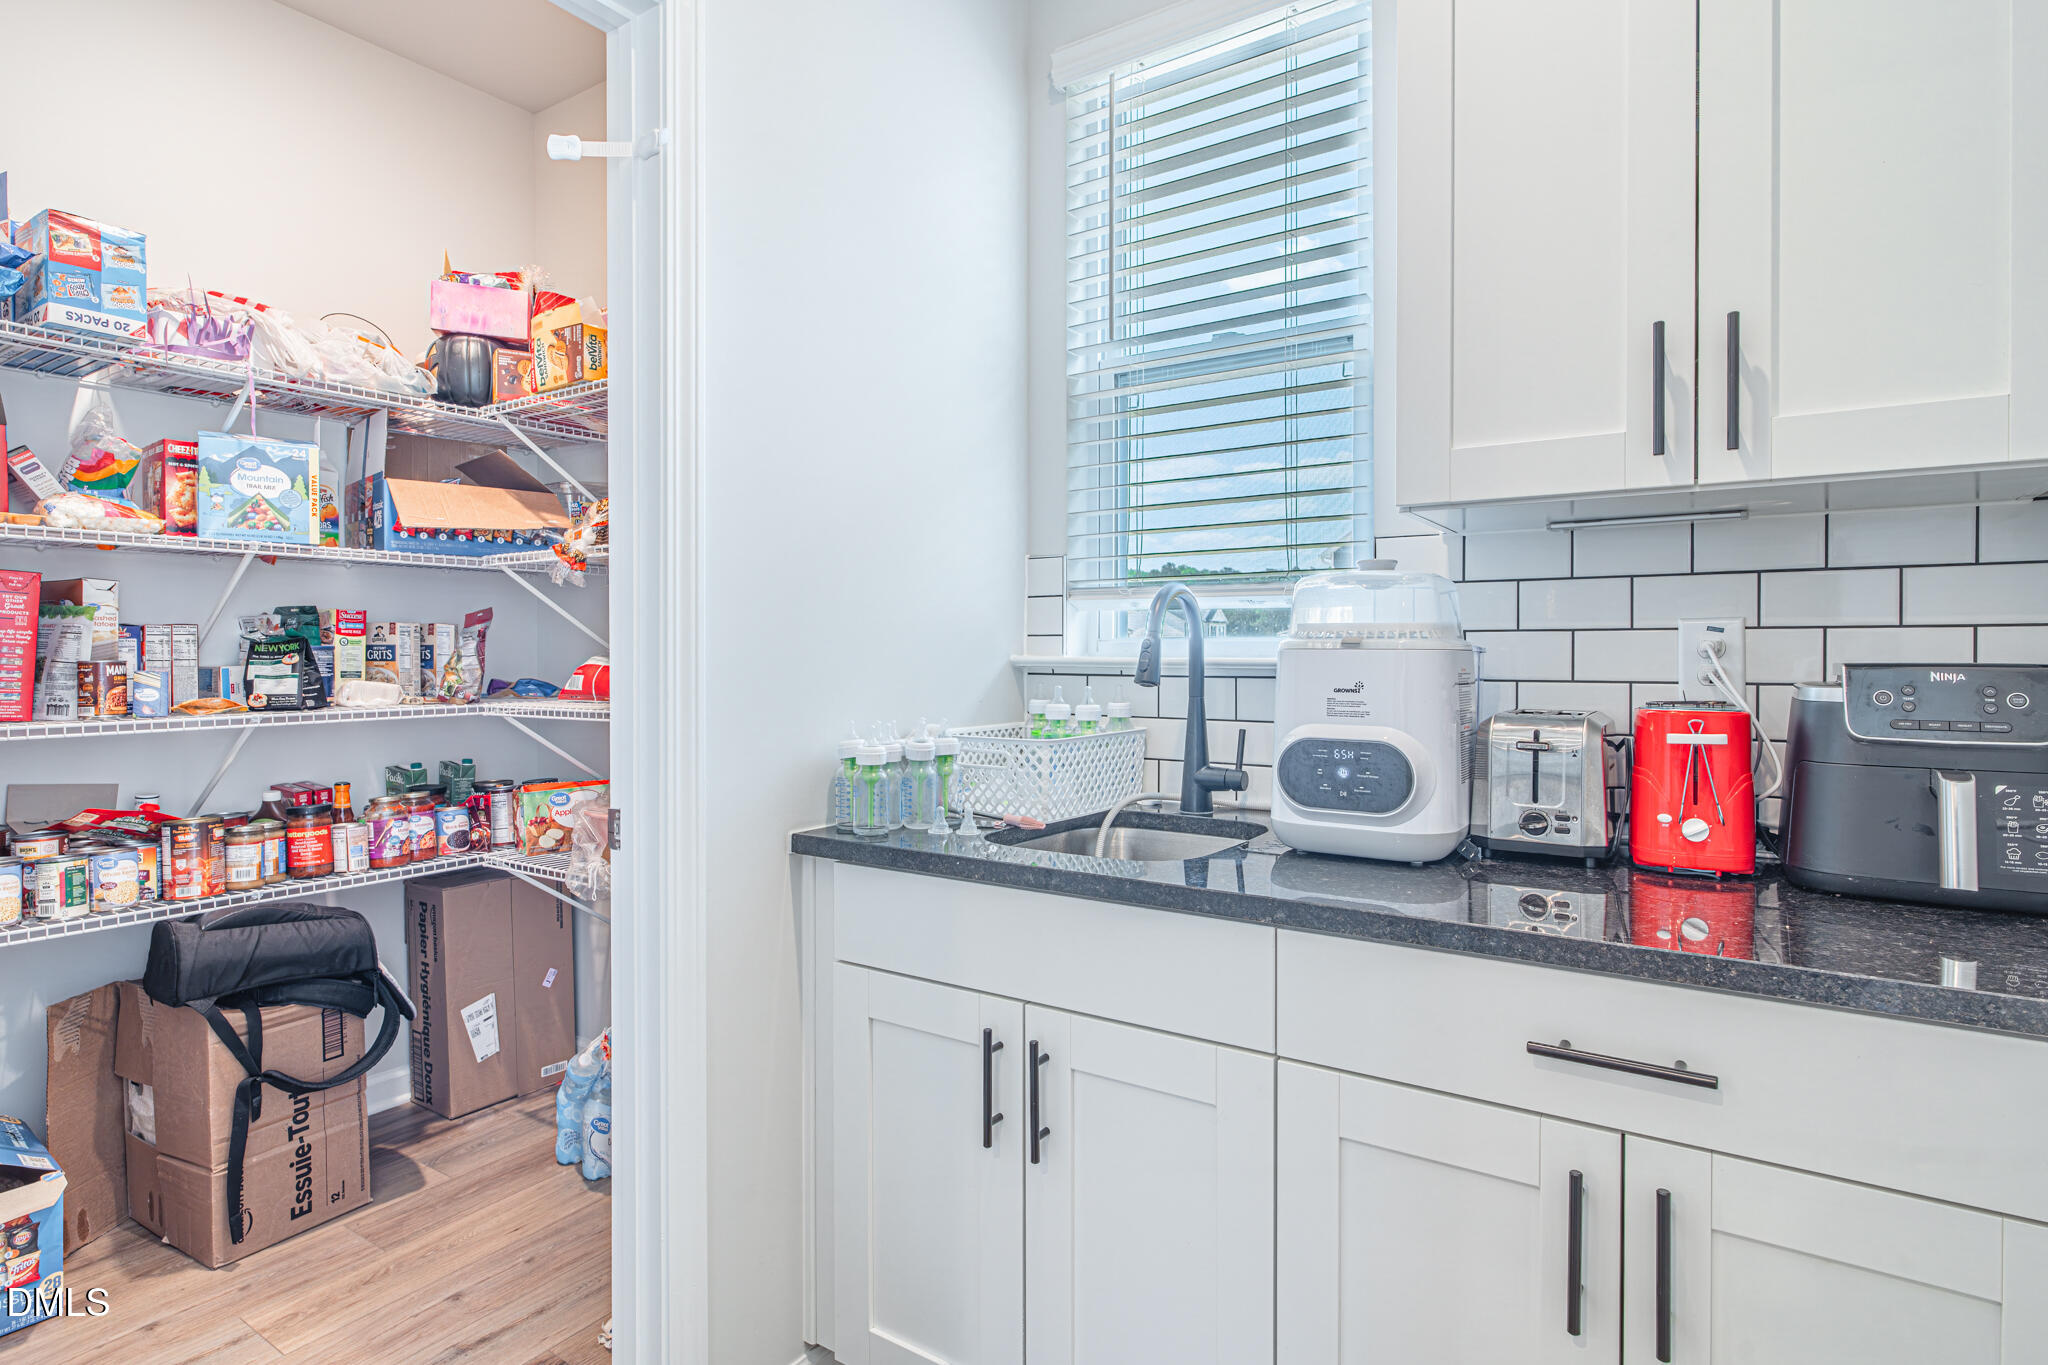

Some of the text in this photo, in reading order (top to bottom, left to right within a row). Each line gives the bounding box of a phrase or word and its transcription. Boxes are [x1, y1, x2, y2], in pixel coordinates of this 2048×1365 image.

[65, 310, 131, 333] 20 PACKS
[237, 473, 284, 484] Mountain
[254, 643, 300, 652] NEW YORK
[367, 650, 393, 660] GRITS
[1929, 671, 1966, 684] NINJA
[417, 901, 434, 1106] Papier Hygiénique Doux
[331, 1191, 341, 1204] 12
[44, 1275, 62, 1292] 28
